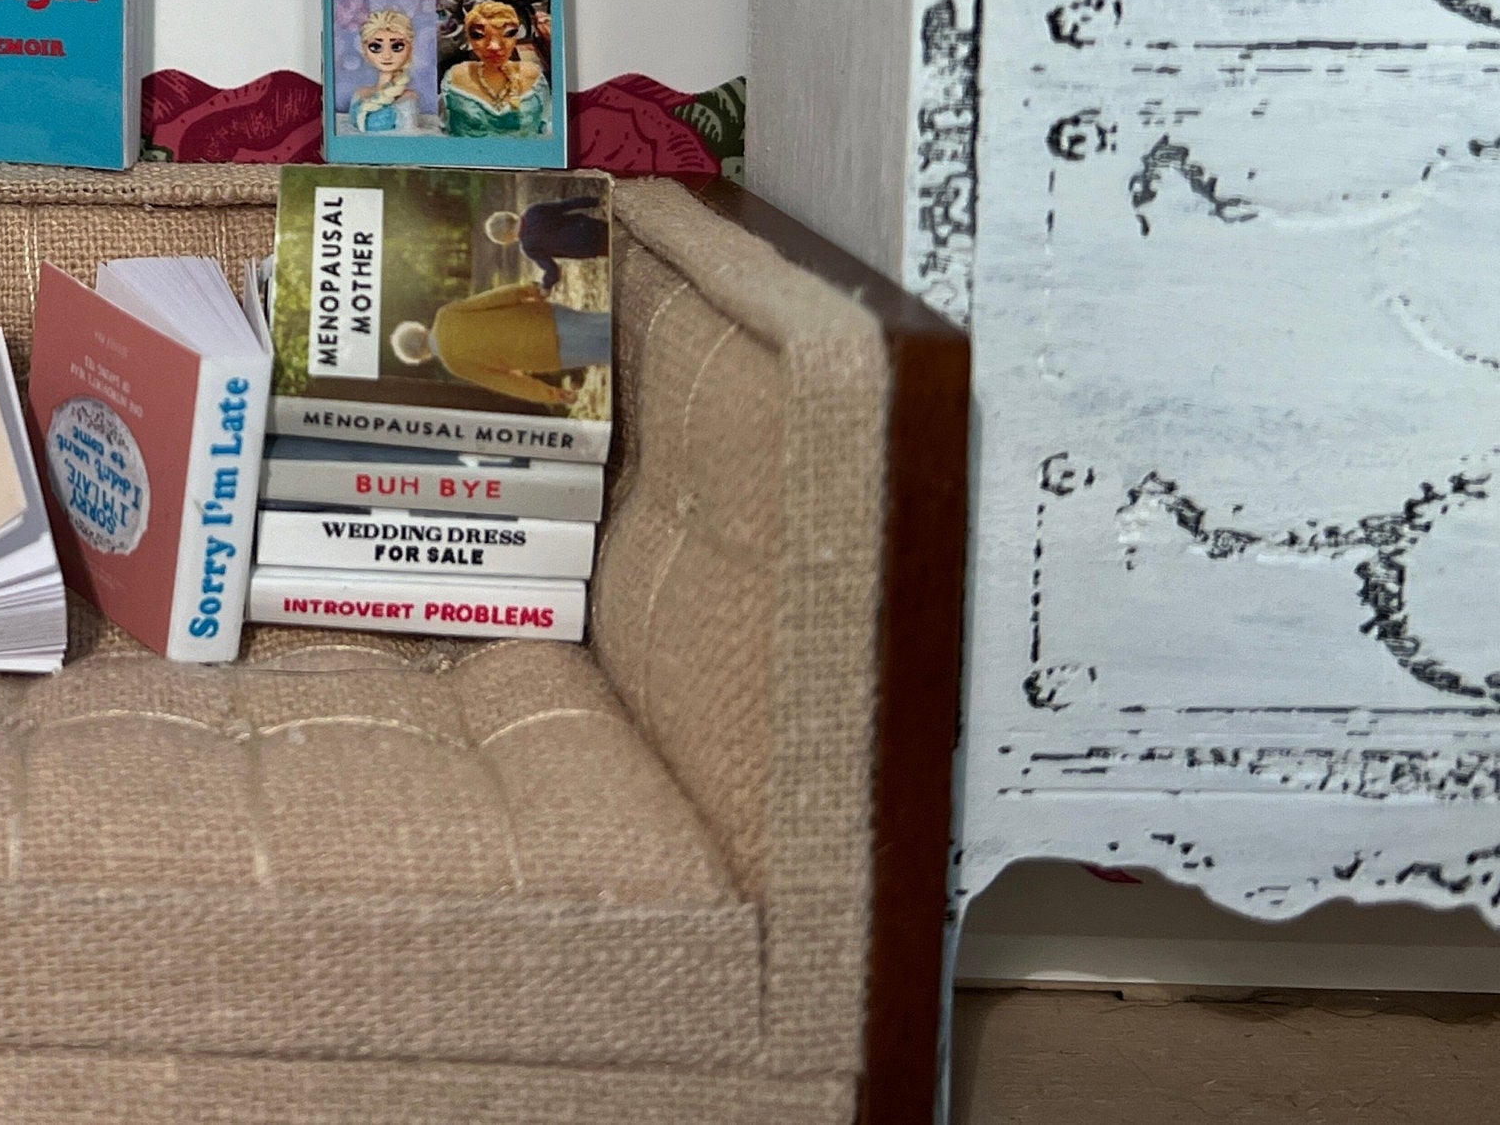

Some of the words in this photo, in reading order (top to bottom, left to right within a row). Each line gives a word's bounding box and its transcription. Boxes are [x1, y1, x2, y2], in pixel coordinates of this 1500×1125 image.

[318, 195, 344, 366] MENOPAUSAL
[351, 231, 374, 335] MOTHER
[210, 377, 249, 457] Late
[303, 412, 465, 440] MENOPAUSAL
[475, 427, 574, 450] MOTHER
[56, 434, 89, 464] want
[73, 425, 104, 456] come
[110, 451, 126, 470] to
[202, 466, 238, 528] I'm
[356, 474, 420, 496] BUH
[439, 478, 502, 499] BYE
[70, 488, 116, 535] SORRY
[322, 521, 443, 543] WEDDING
[447, 526, 527, 546] DRESS
[375, 545, 419, 562] FOR
[427, 547, 484, 565] SALE
[189, 535, 237, 639] Sorry
[284, 597, 414, 620] INTROVERT
[425, 604, 554, 629] PROBLEMS
